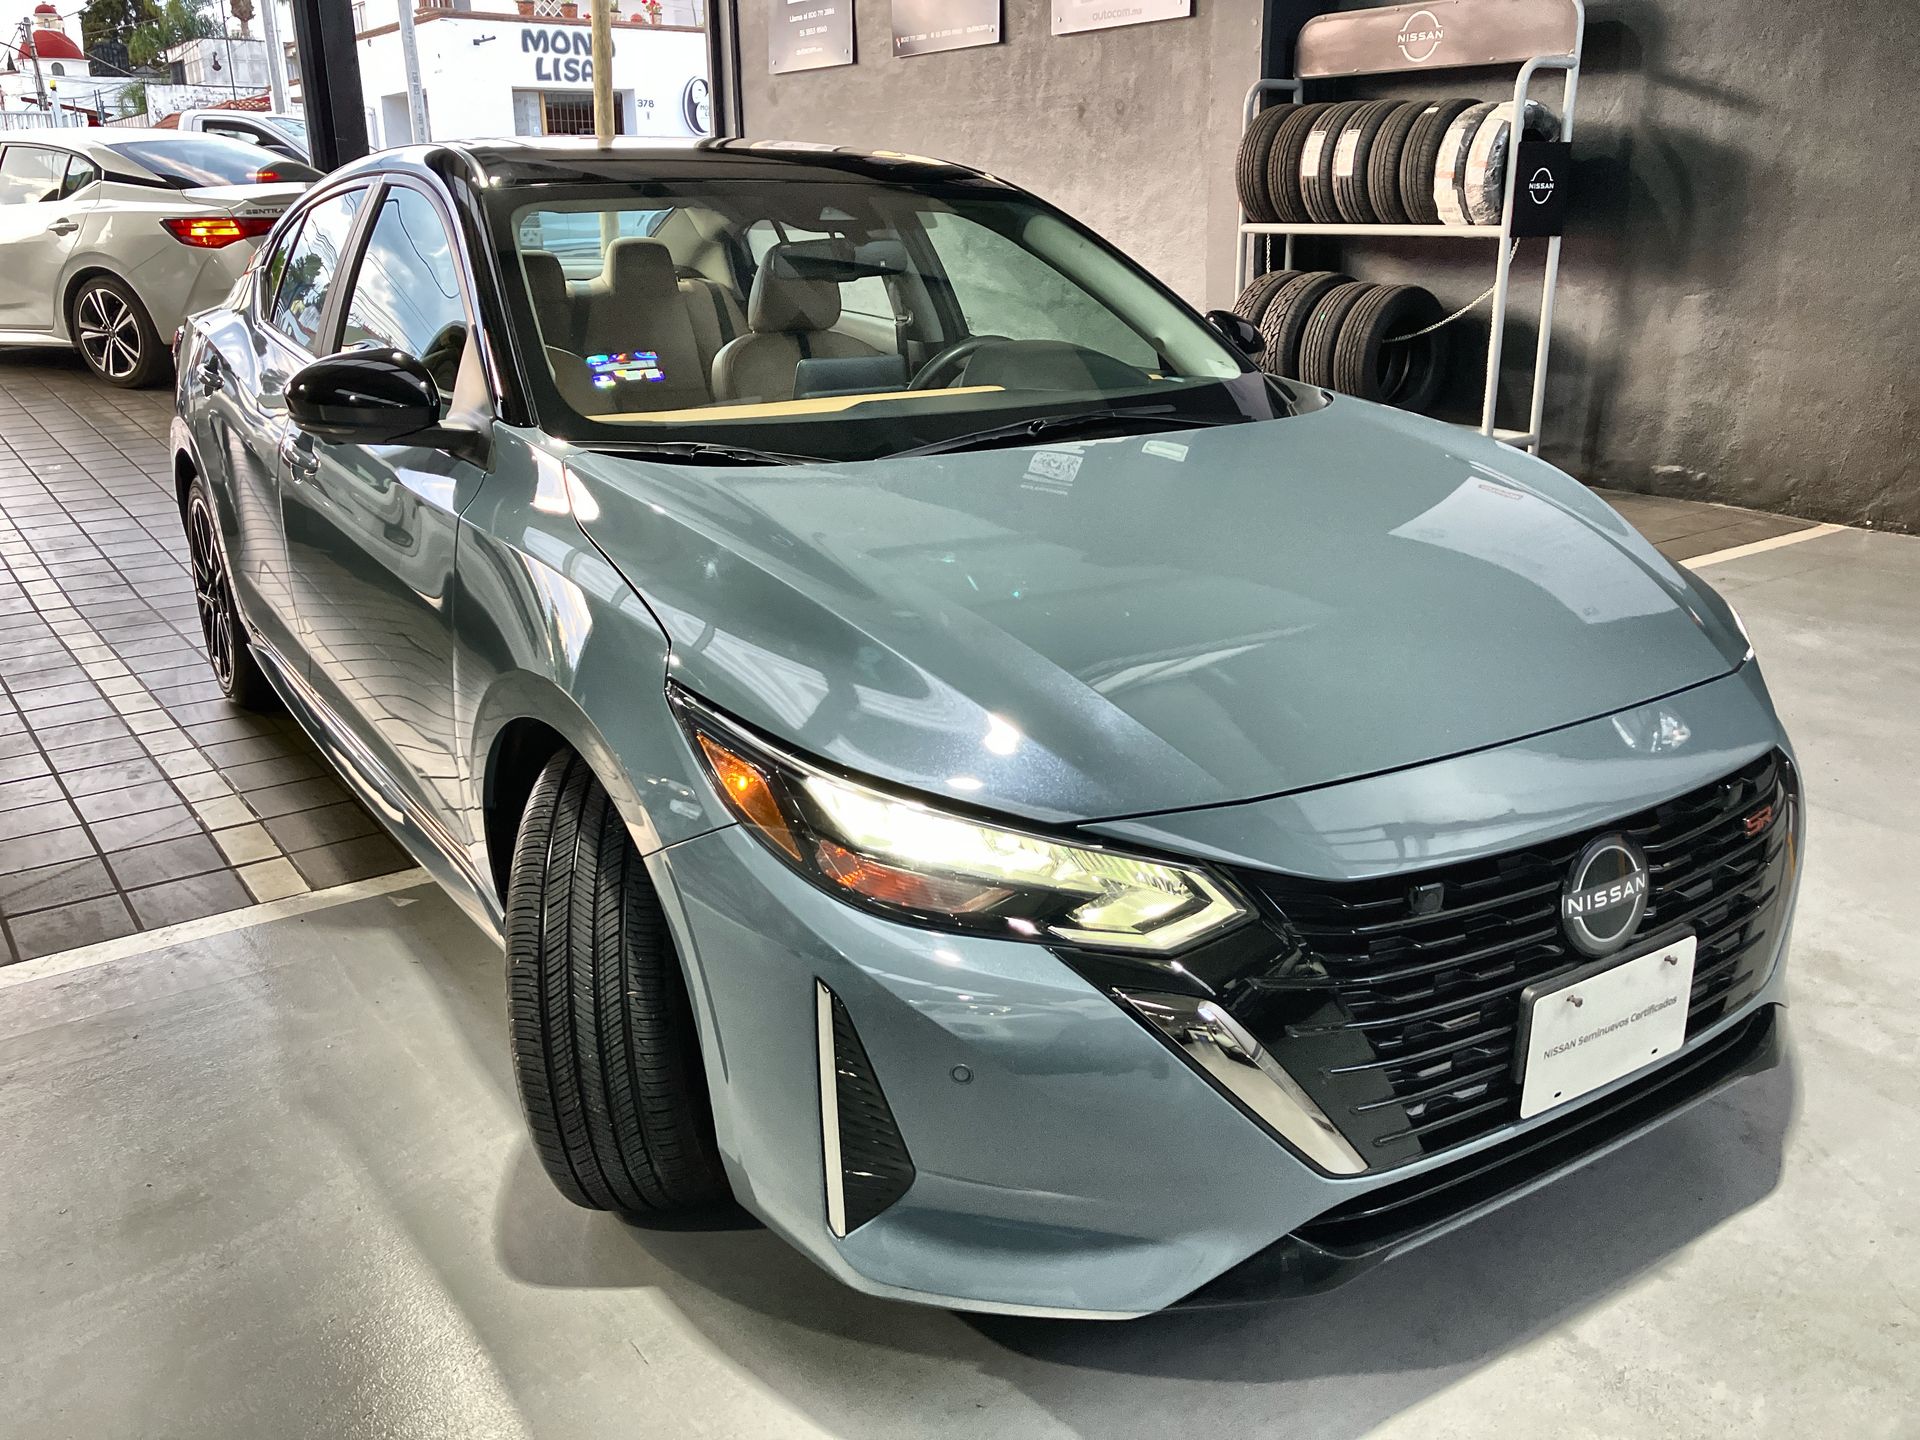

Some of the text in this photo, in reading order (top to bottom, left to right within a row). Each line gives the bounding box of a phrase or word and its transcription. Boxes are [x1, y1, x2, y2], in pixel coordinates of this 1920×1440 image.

[1092, 8, 1143, 21] autocom.mx
[521, 28, 616, 57] MON
[1397, 29, 1444, 43] NISSAN
[637, 99, 655, 108] 378
[1528, 182, 1555, 190] NISSAN
[1744, 805, 1773, 837] SR
[1567, 873, 1646, 915] NISSAN
[1543, 996, 1677, 1060] NISSAN Seminuevos Certificados
